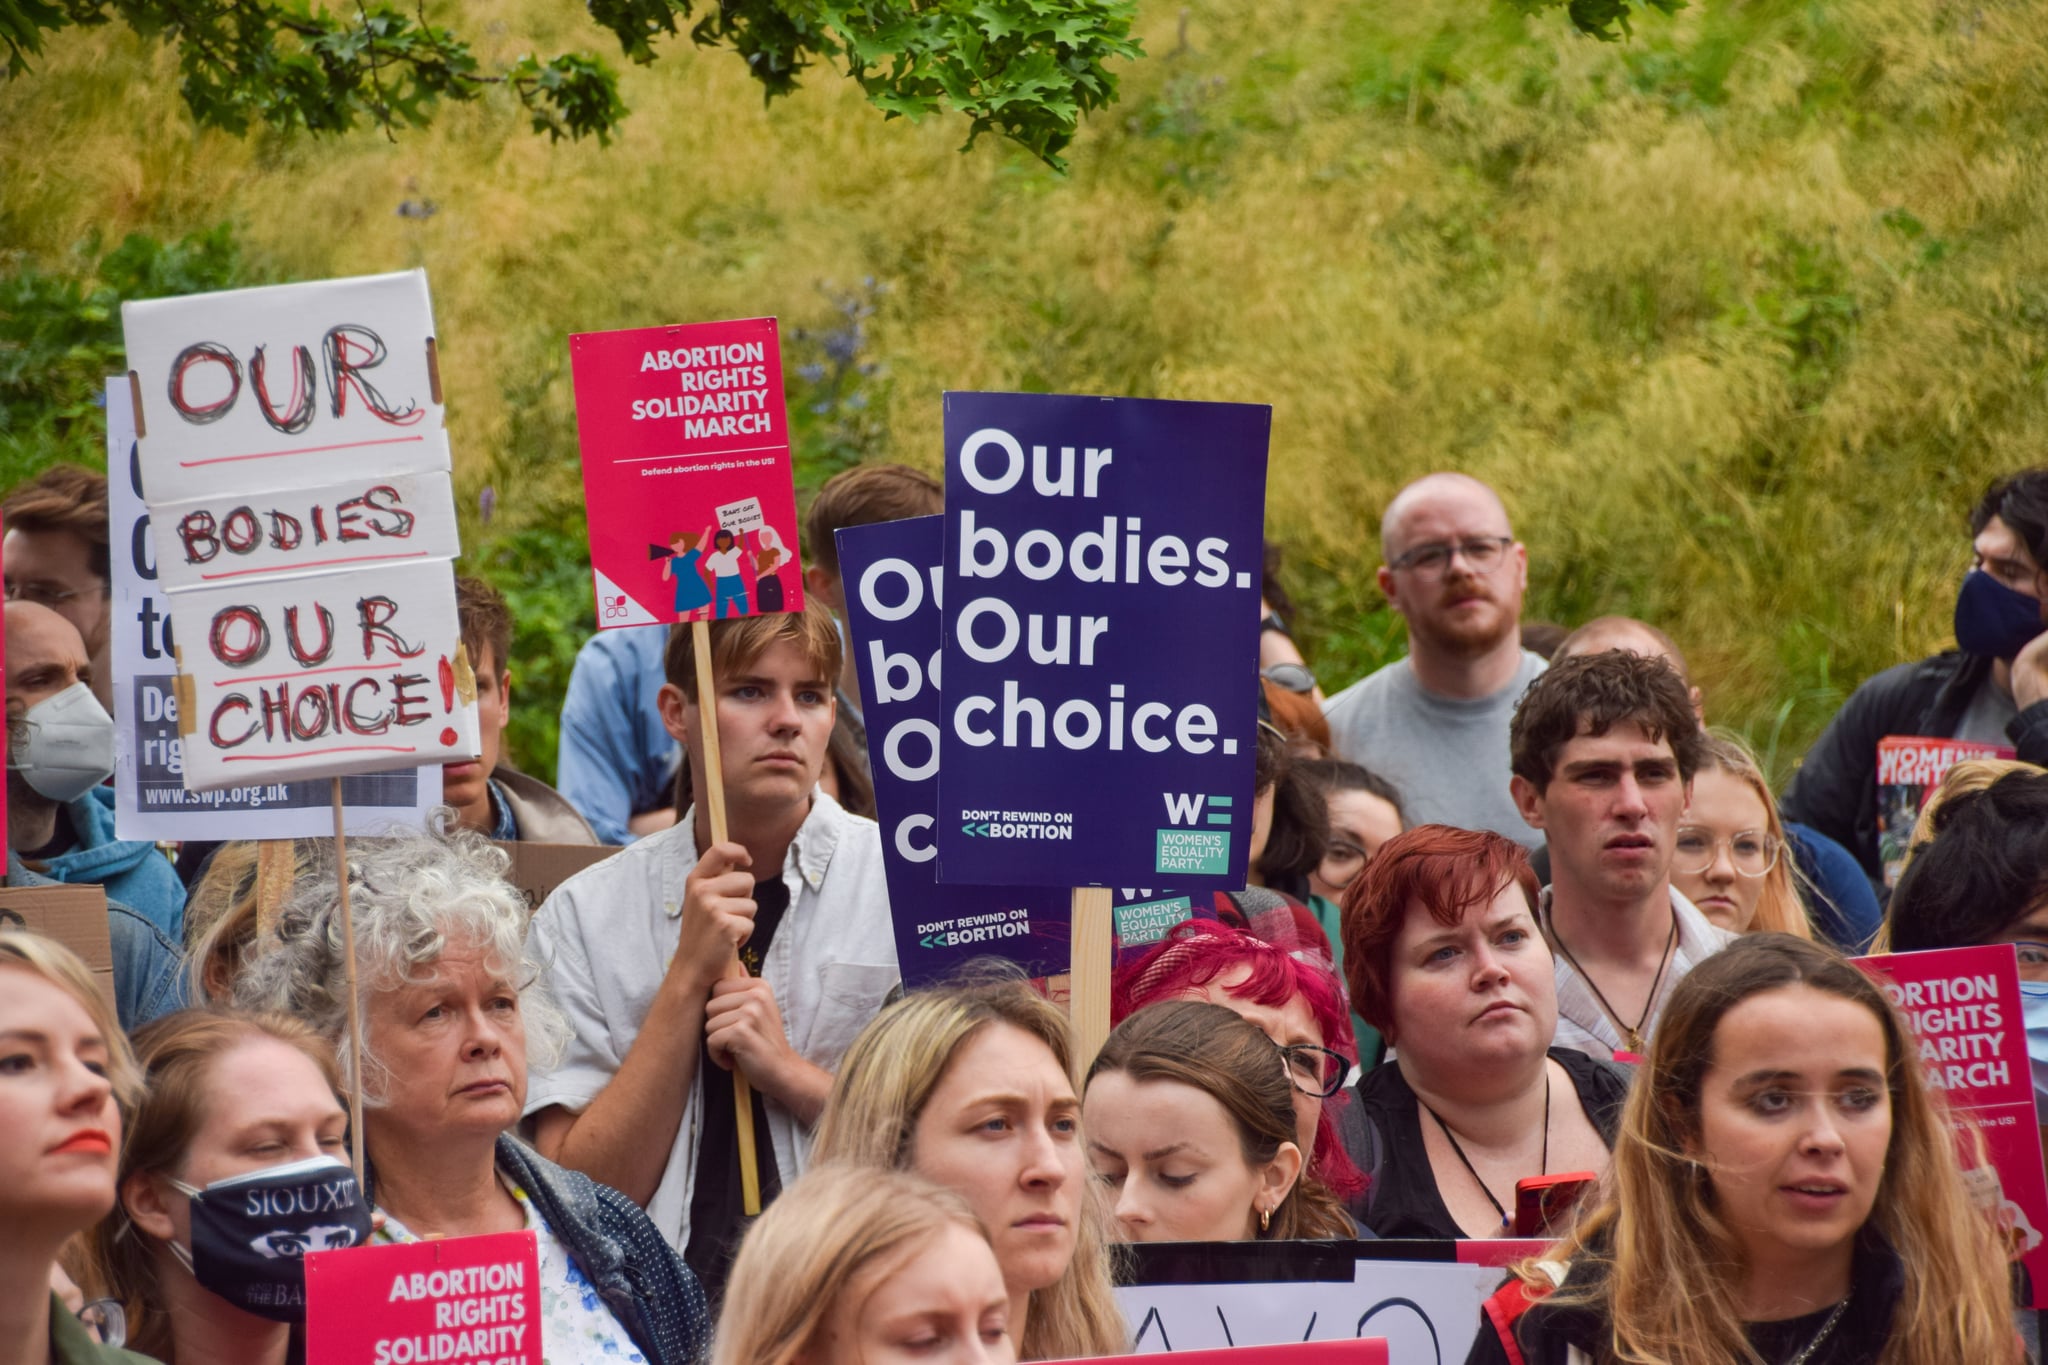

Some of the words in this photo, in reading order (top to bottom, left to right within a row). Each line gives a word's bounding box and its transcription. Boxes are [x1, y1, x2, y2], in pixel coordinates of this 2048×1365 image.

[640, 341, 765, 372] ABORTION
[168, 323, 425, 434] OUR
[681, 365, 767, 392] RIGHTS
[631, 389, 769, 420] SOLIDARITY
[684, 413, 771, 440] MARCH
[641, 466, 673, 476] Defend
[673, 463, 710, 474] abortion
[710, 460, 735, 471] rights
[736, 458, 745, 468] in
[745, 457, 760, 467] the
[761, 457, 776, 466] US!
[959, 427, 1113, 498] Our
[177, 484, 414, 565] BODIES
[959, 510, 1251, 589] bodies.
[208, 595, 426, 668] OUR
[956, 597, 1108, 666] Our
[208, 654, 459, 748] CHOICE!
[953, 680, 1238, 756] choice.
[145, 783, 288, 808] www.swp.org.uk
[961, 810, 1000, 822] DON'T
[1002, 811, 1052, 823] REWIND
[1054, 813, 1073, 824] ON
[1161, 833, 1222, 847] WOMEN'S
[1161, 846, 1224, 858] EQUALITY
[1161, 858, 1205, 870] PARTY.
[917, 919, 955, 934] DON'T
[957, 912, 1007, 929] REWIND
[1009, 908, 1028, 920] ON
[1119, 902, 1182, 922] WOMEN'S
[1120, 912, 1186, 933] EQUALITY
[1883, 974, 1999, 1007] ORTION
[1919, 1031, 2005, 1062] ARITY
[1925, 1060, 2011, 1092] ARCH
[1998, 1116, 2016, 1126] US!
[389, 1262, 524, 1302] ABORTION
[247, 1293, 271, 1305] THE
[436, 1294, 526, 1329] RIGHTS
[374, 1324, 527, 1365] SOLIDARITY
